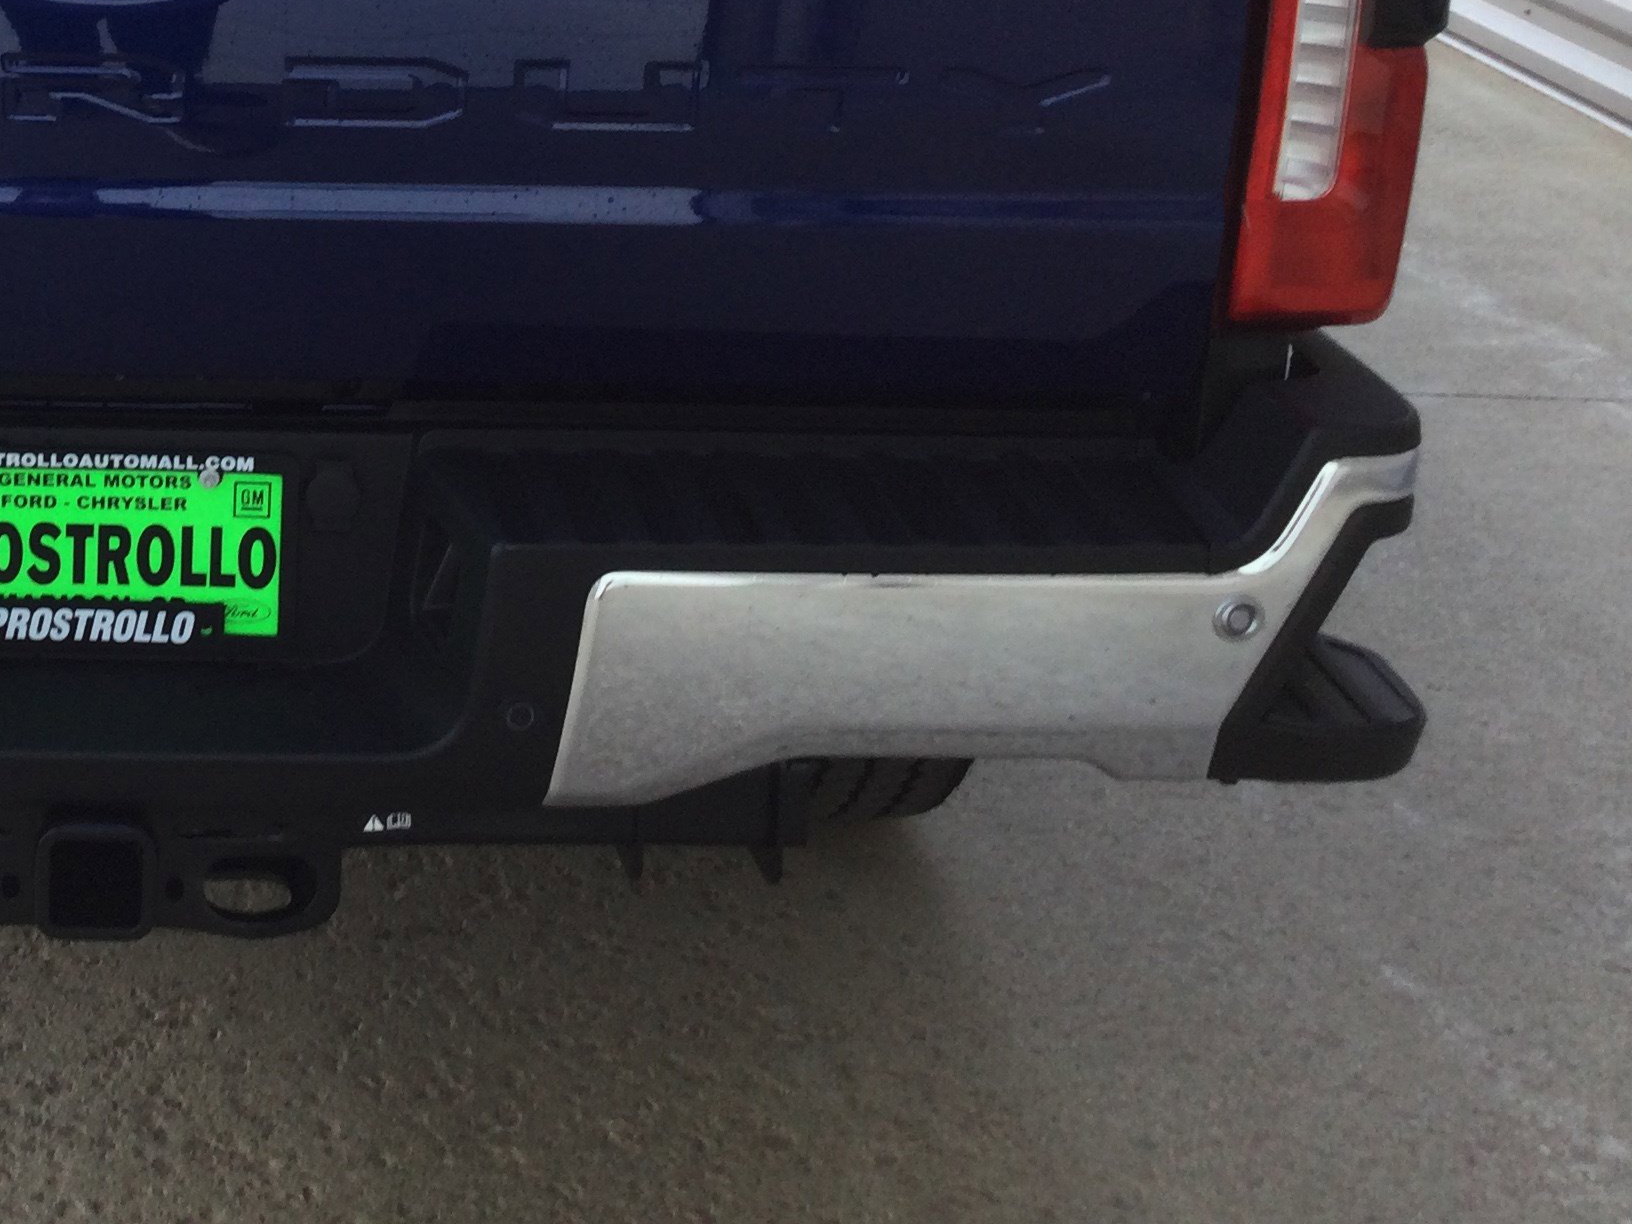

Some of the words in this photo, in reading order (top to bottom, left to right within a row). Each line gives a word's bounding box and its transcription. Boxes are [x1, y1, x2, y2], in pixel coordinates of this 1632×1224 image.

[104, 474, 192, 489] MOTORS
[1, 494, 57, 509] FORD
[76, 496, 187, 511] CHRYSLER
[241, 489, 264, 505] GM
